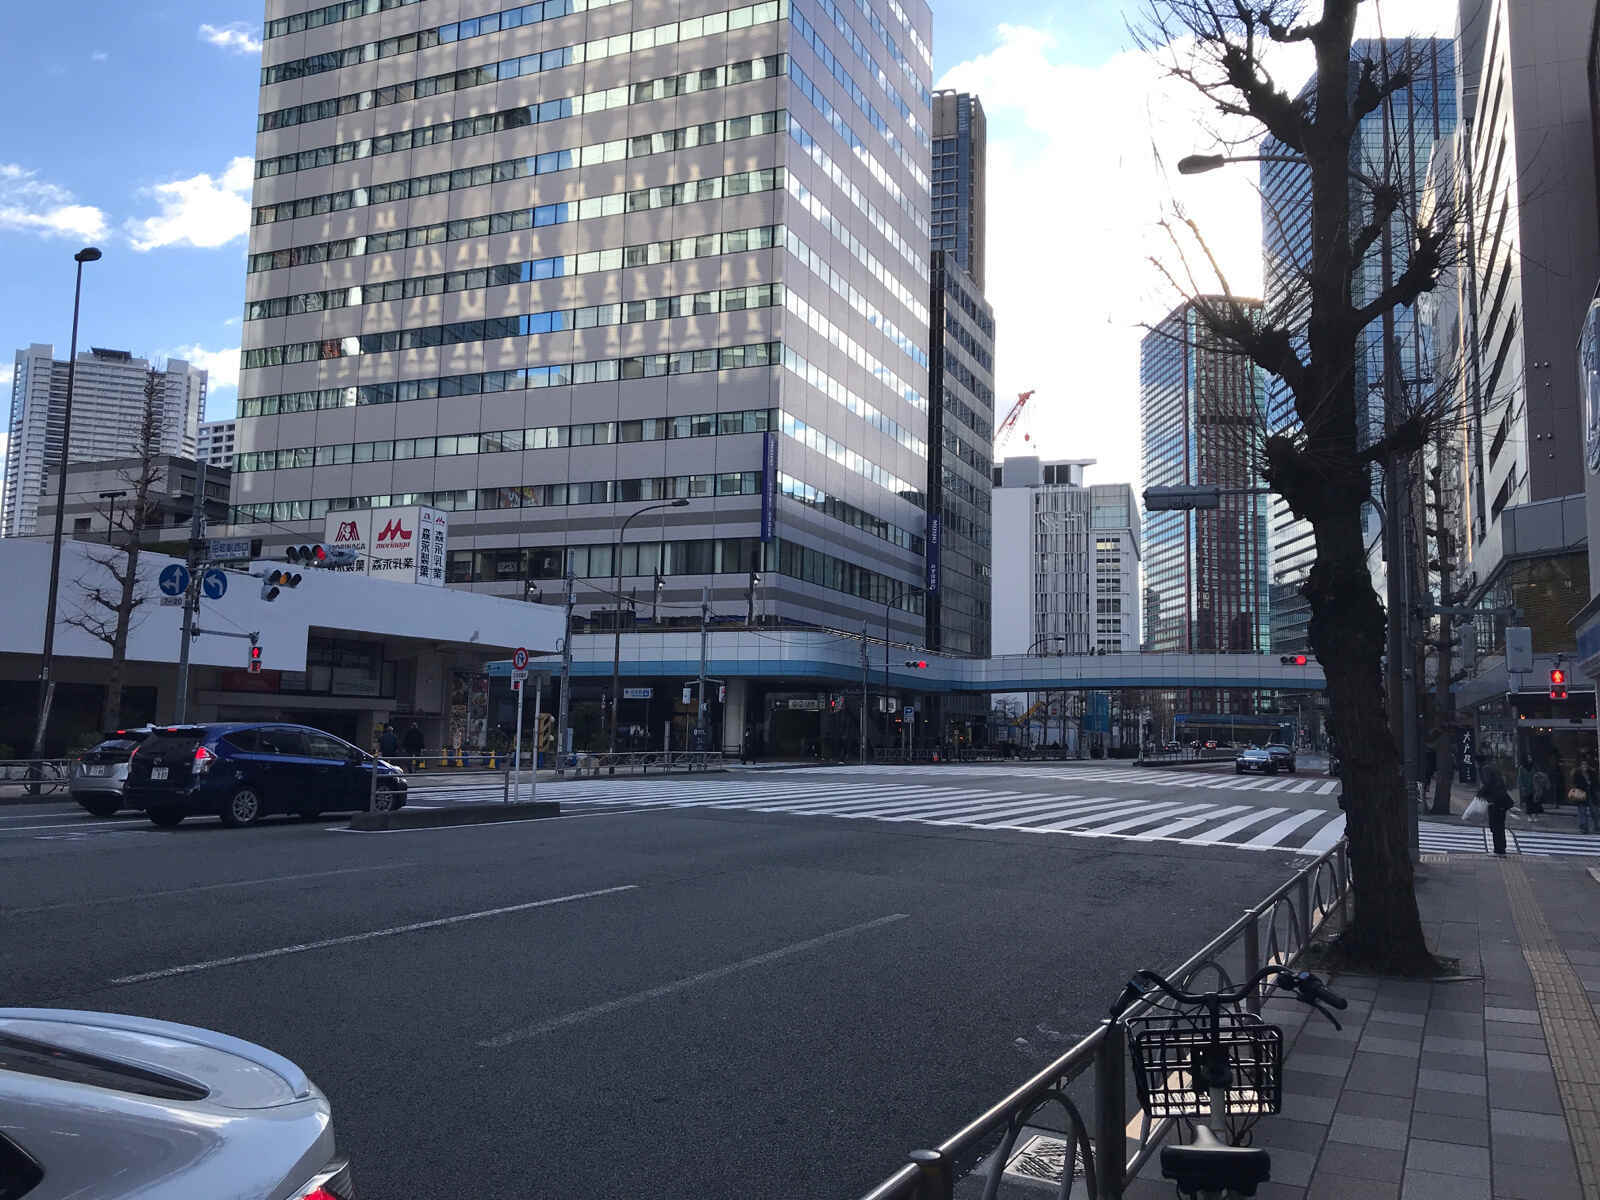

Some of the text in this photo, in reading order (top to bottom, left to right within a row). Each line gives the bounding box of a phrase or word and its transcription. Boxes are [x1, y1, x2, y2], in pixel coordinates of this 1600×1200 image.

[376, 542, 410, 550] morinaga
[420, 528, 431, 578] 森永製菓
[433, 530, 444, 580] 森永乳業
[372, 558, 414, 570] 森永乳業
